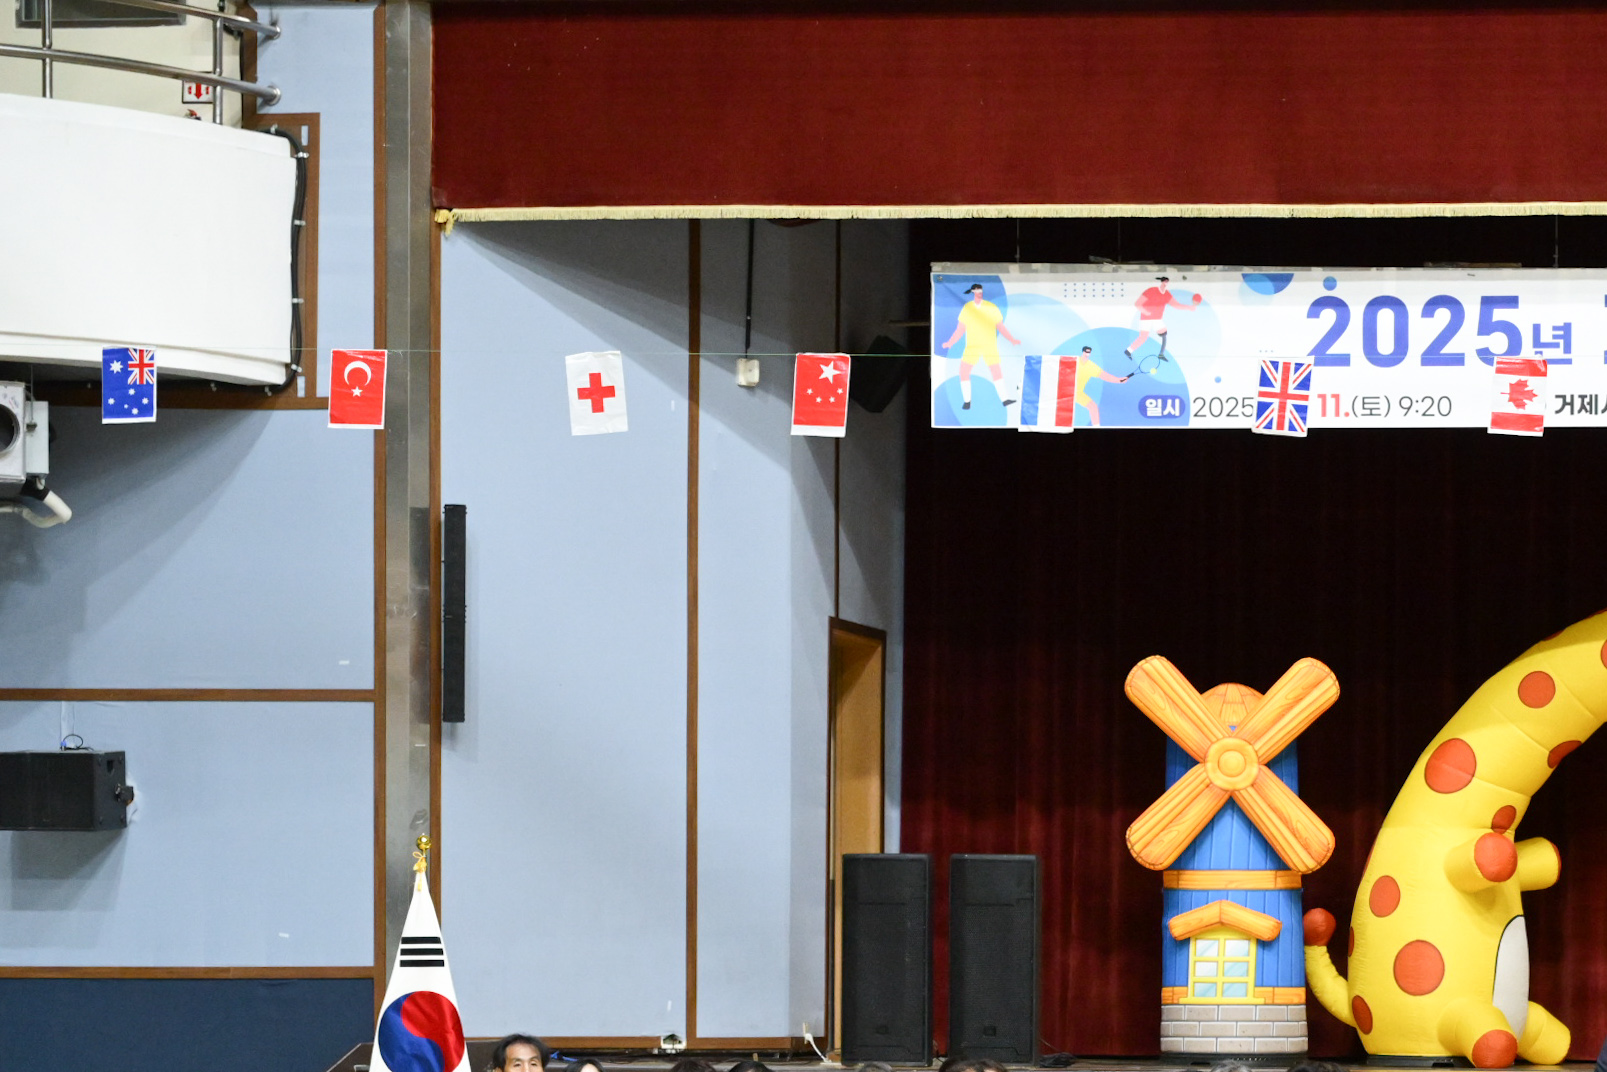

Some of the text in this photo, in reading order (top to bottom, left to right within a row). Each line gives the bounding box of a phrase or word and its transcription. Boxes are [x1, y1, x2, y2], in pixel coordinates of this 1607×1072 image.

[1306, 293, 1573, 368] 2025년
[1145, 398, 1181, 417] 일시
[1398, 395, 1452, 418] 9:20
